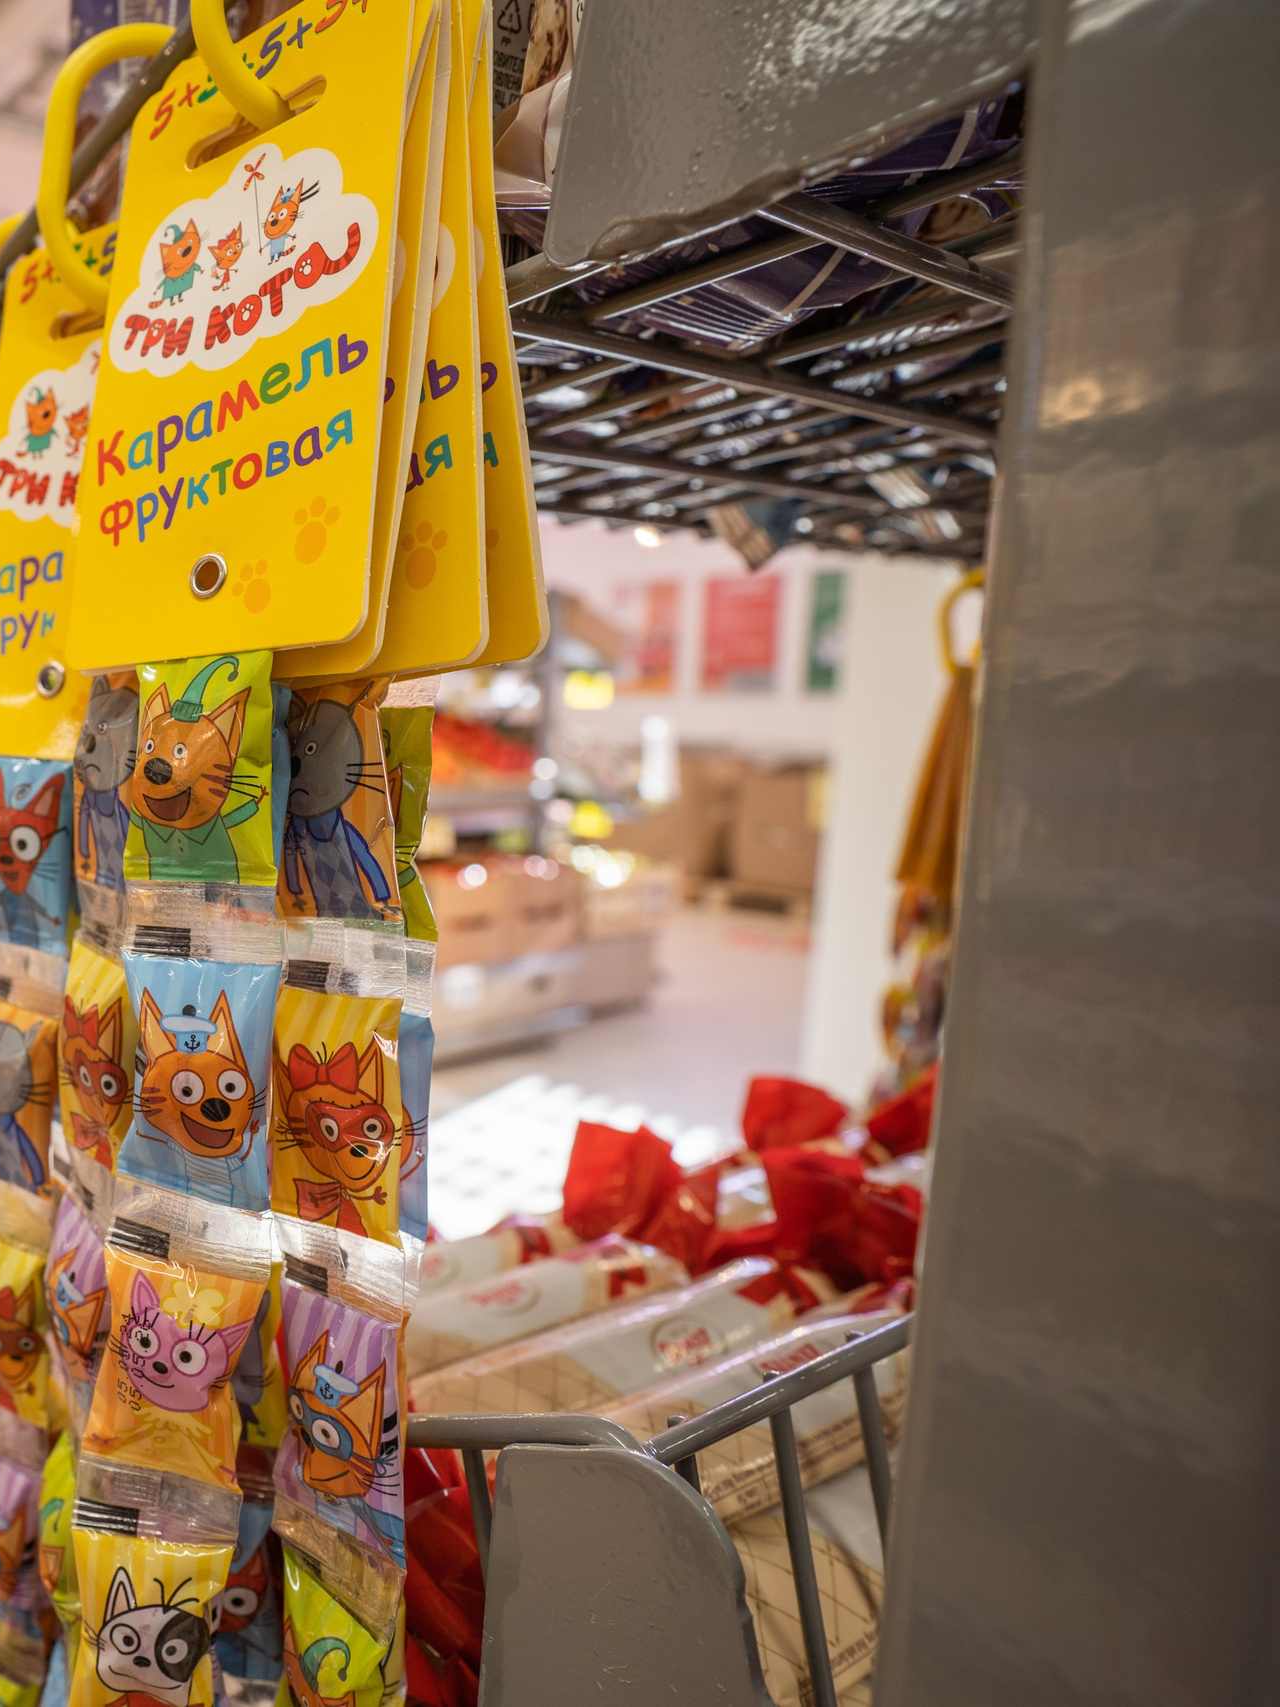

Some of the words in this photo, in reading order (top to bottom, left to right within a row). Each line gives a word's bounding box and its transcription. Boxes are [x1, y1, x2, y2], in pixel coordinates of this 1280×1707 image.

[123, 313, 194, 359] ТРИ
[97, 333, 369, 487] Карамель
[99, 409, 354, 547] фруктовая
